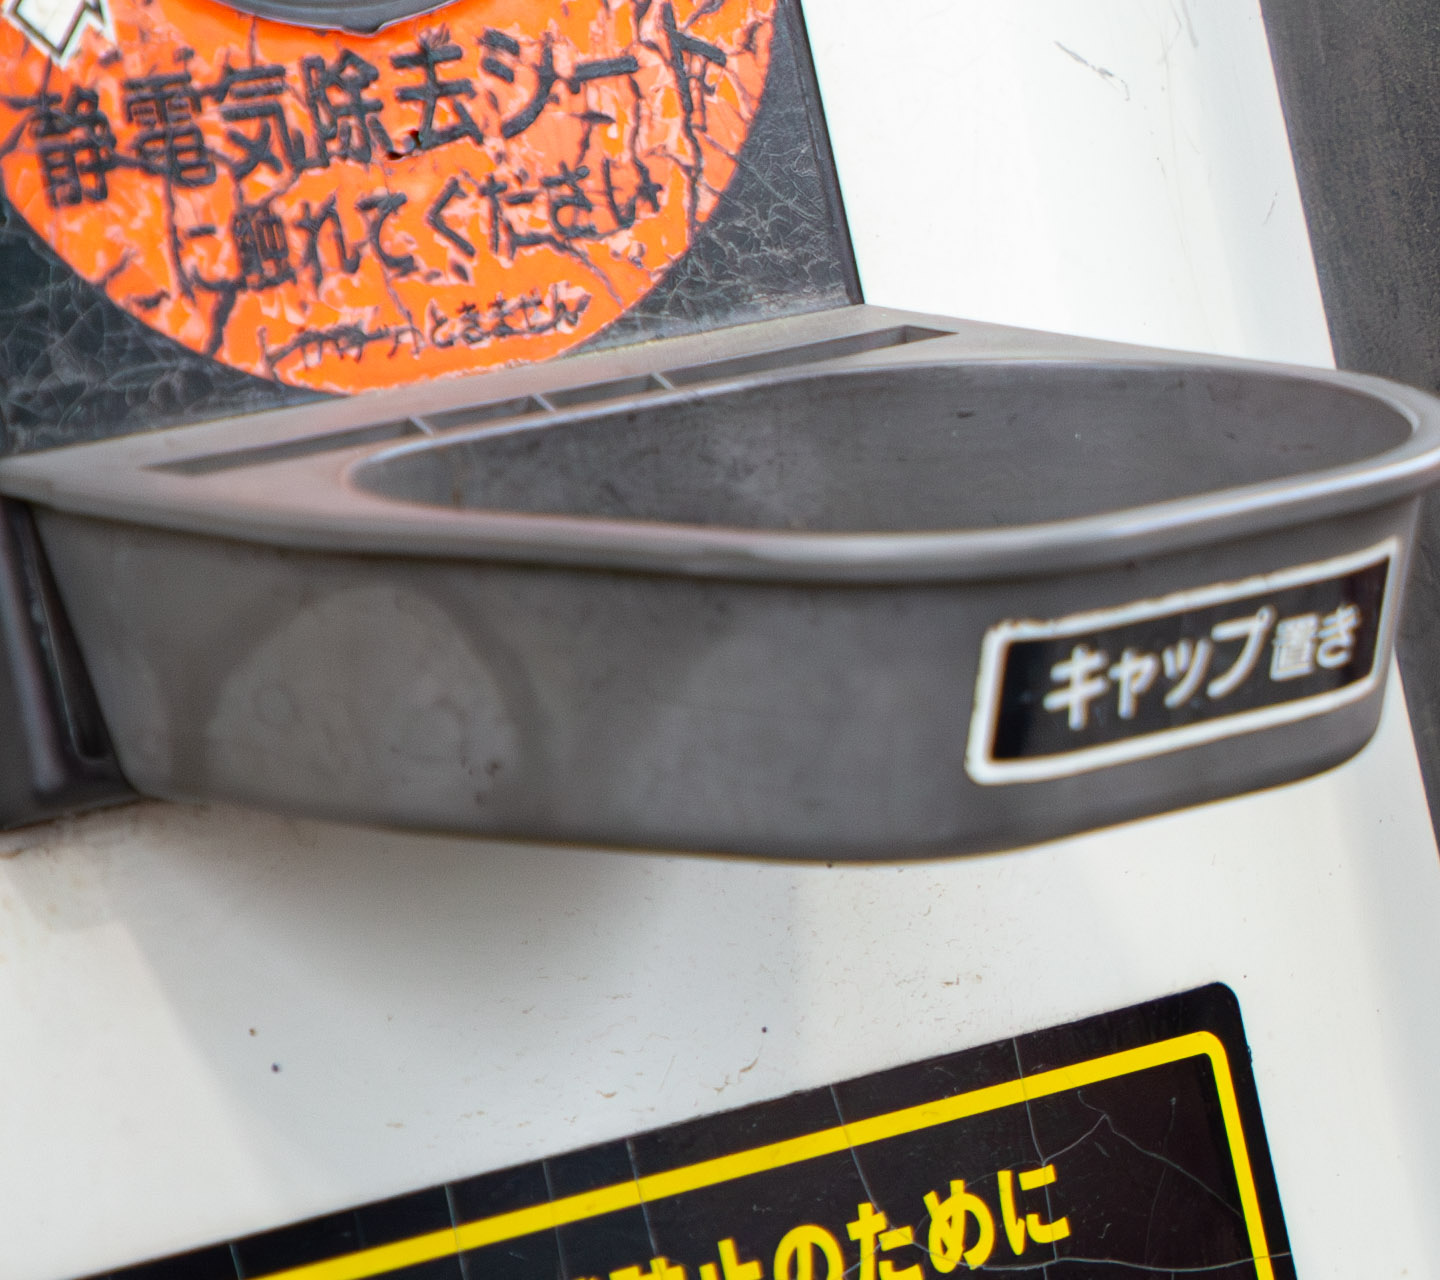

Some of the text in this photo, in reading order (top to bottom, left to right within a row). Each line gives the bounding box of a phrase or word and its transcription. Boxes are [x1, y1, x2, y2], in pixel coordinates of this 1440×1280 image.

[28, 4, 728, 207] 静電気除去シート
[172, 160, 662, 298] に触れてください
[1042, 604, 1362, 731] キャップ置き
